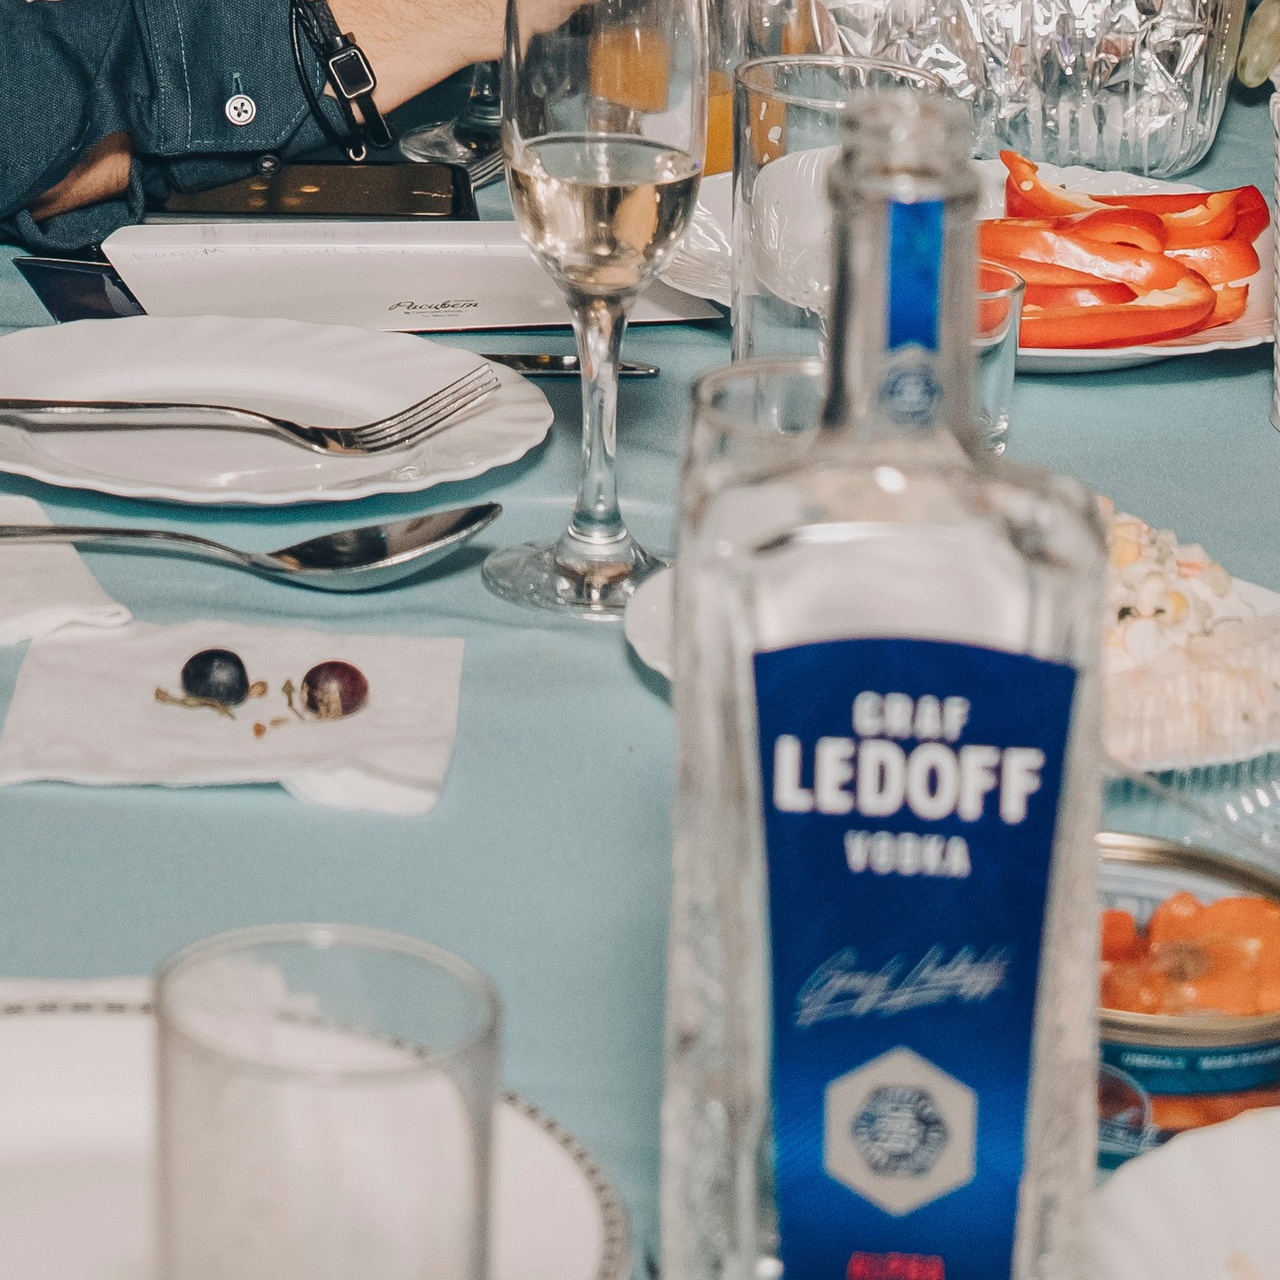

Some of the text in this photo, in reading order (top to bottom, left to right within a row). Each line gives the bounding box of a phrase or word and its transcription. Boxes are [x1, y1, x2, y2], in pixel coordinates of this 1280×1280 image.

[852, 690, 970, 743] GRAF
[773, 733, 1046, 826] LEDOFF
[843, 829, 972, 879] VODKA
